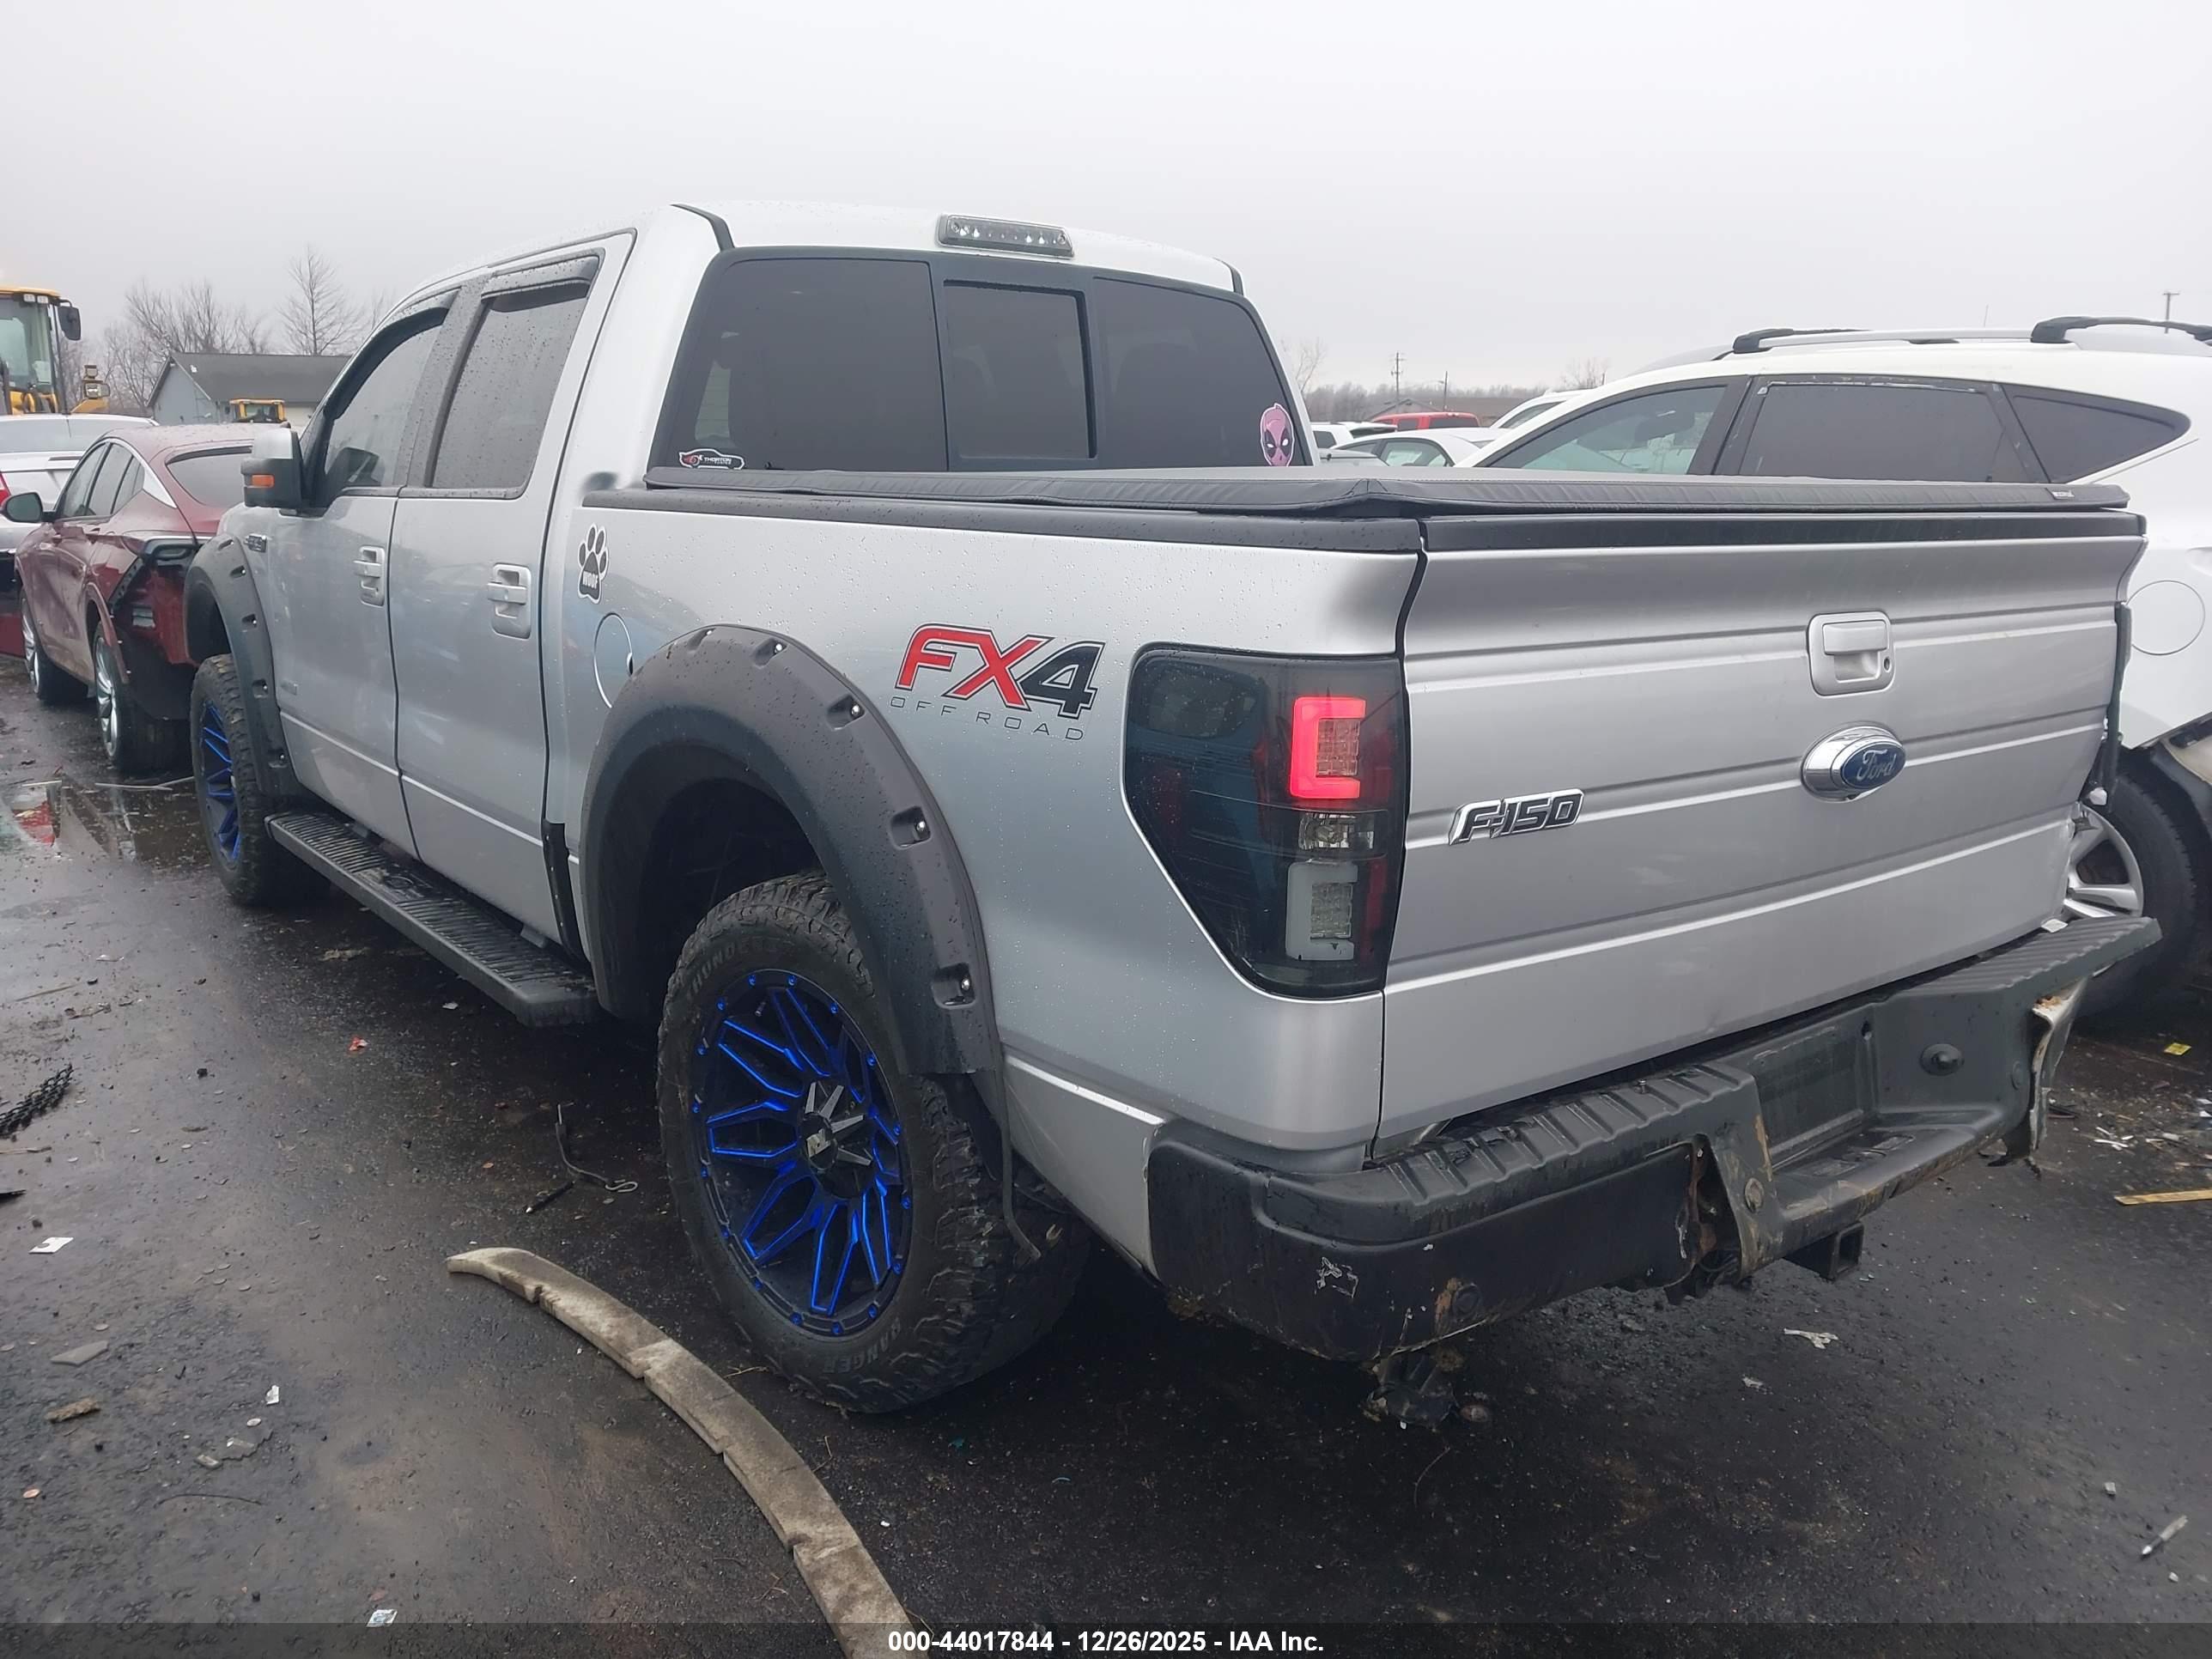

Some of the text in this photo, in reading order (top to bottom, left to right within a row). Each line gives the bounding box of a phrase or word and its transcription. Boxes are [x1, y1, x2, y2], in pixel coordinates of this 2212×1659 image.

[582, 570, 599, 590] WOOF
[895, 623, 1105, 719] FX4
[890, 696, 1084, 741] OFF ROAD
[1856, 749, 1897, 781] Ford
[1449, 788, 1584, 846] F-150
